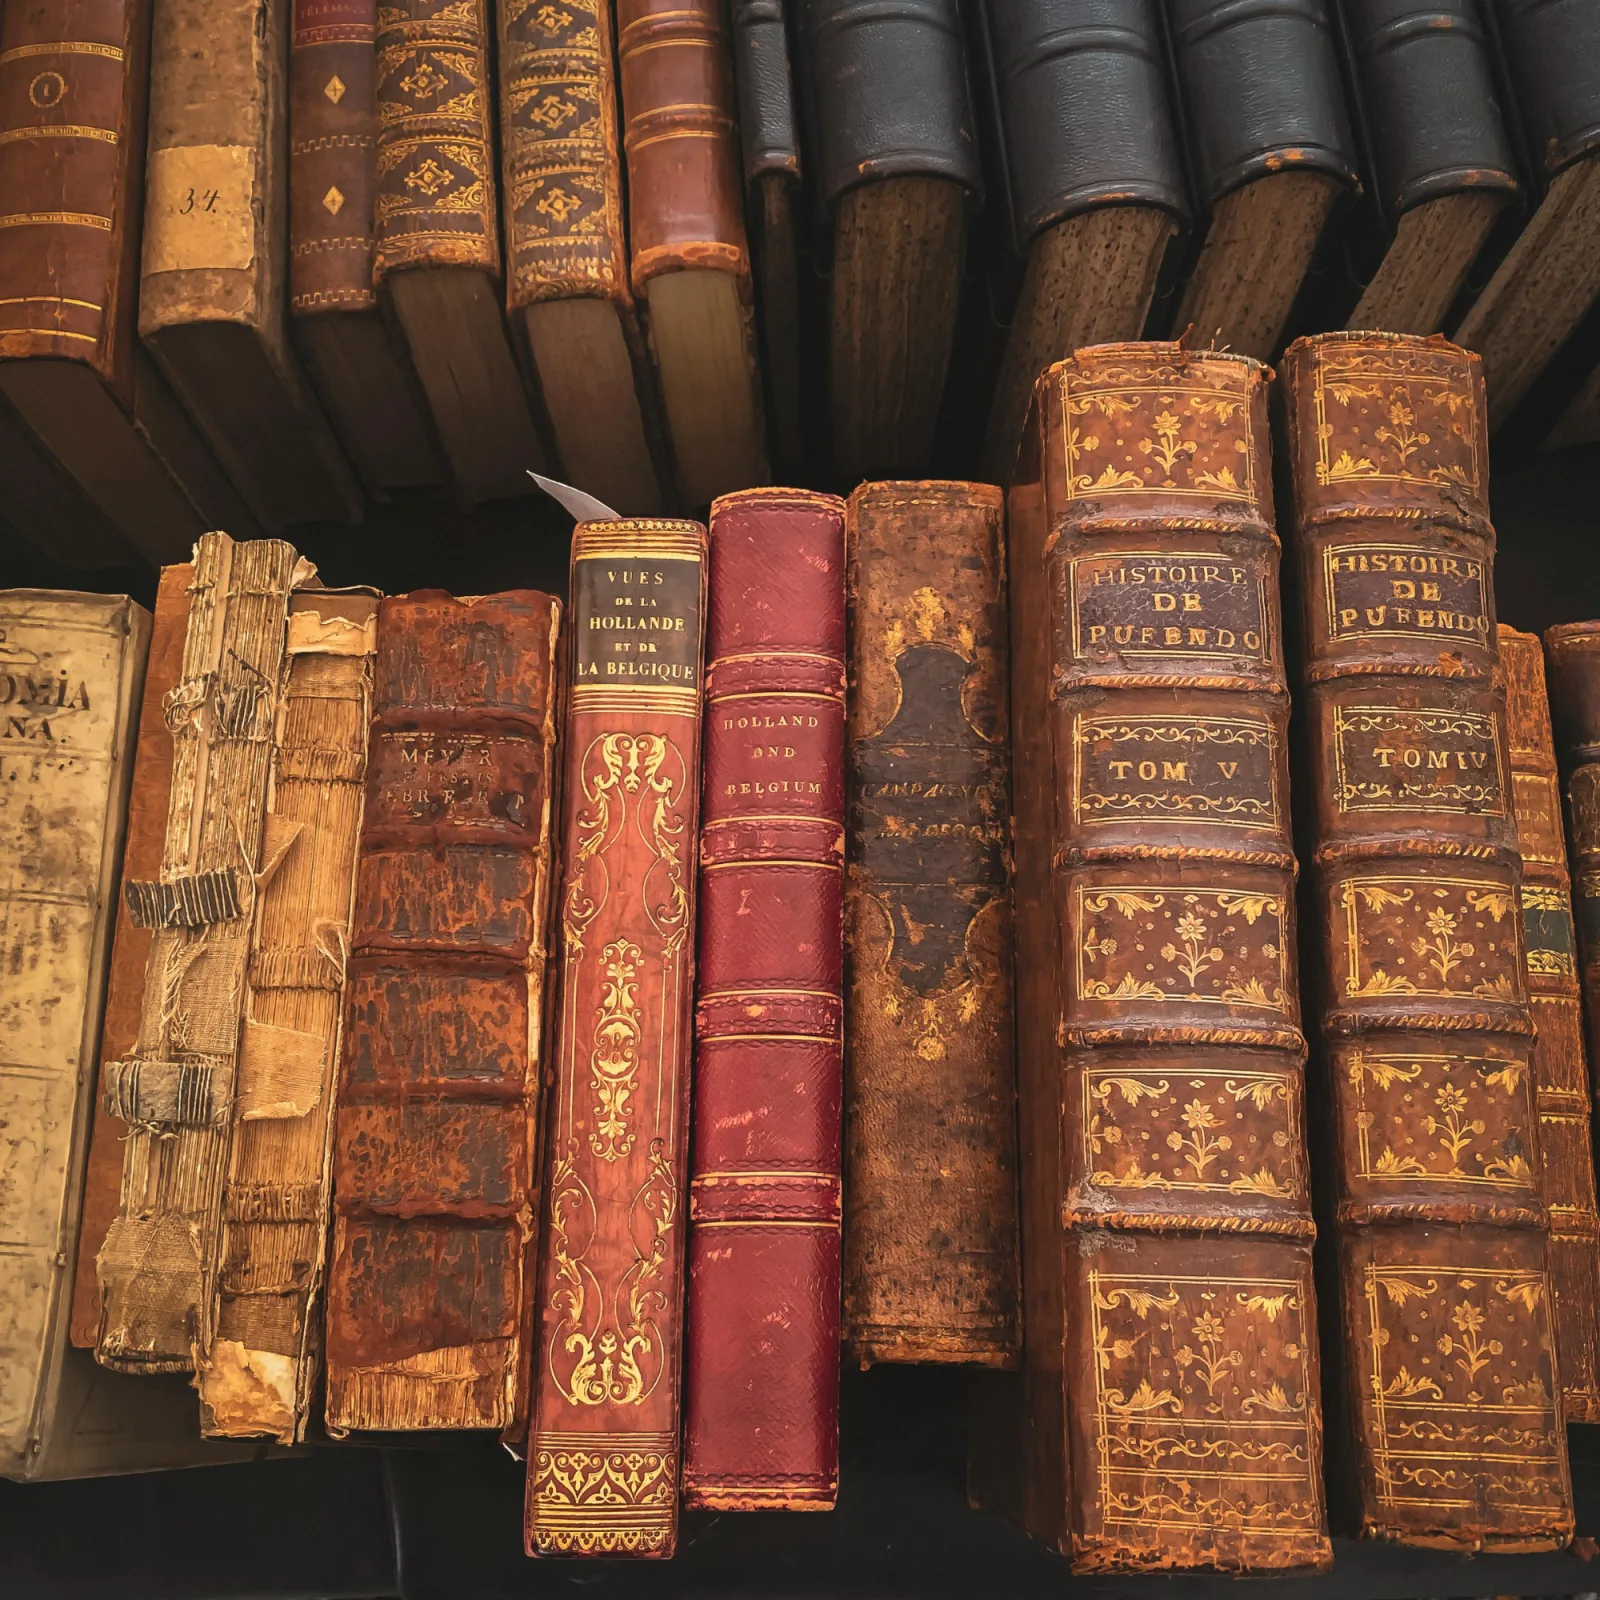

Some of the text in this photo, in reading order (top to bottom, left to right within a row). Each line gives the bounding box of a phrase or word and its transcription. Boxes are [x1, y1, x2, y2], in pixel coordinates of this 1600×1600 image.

[1093, 565, 1249, 586] HISTOIRE
[1330, 554, 1482, 581] HISTOIRE
[607, 571, 664, 585] VUES
[1389, 579, 1442, 602] DE
[615, 597, 657, 606] DE LA
[1152, 593, 1203, 612] DE
[589, 616, 685, 632] HOLLANDE
[1089, 624, 1262, 651] PUFENDO
[615, 642, 657, 653] ET DE
[578, 661, 694, 681] LA BELGIQUE
[723, 715, 819, 731] HOLLAND
[1109, 760, 1239, 783] TOM V
[726, 780, 822, 796] BELGIUM
